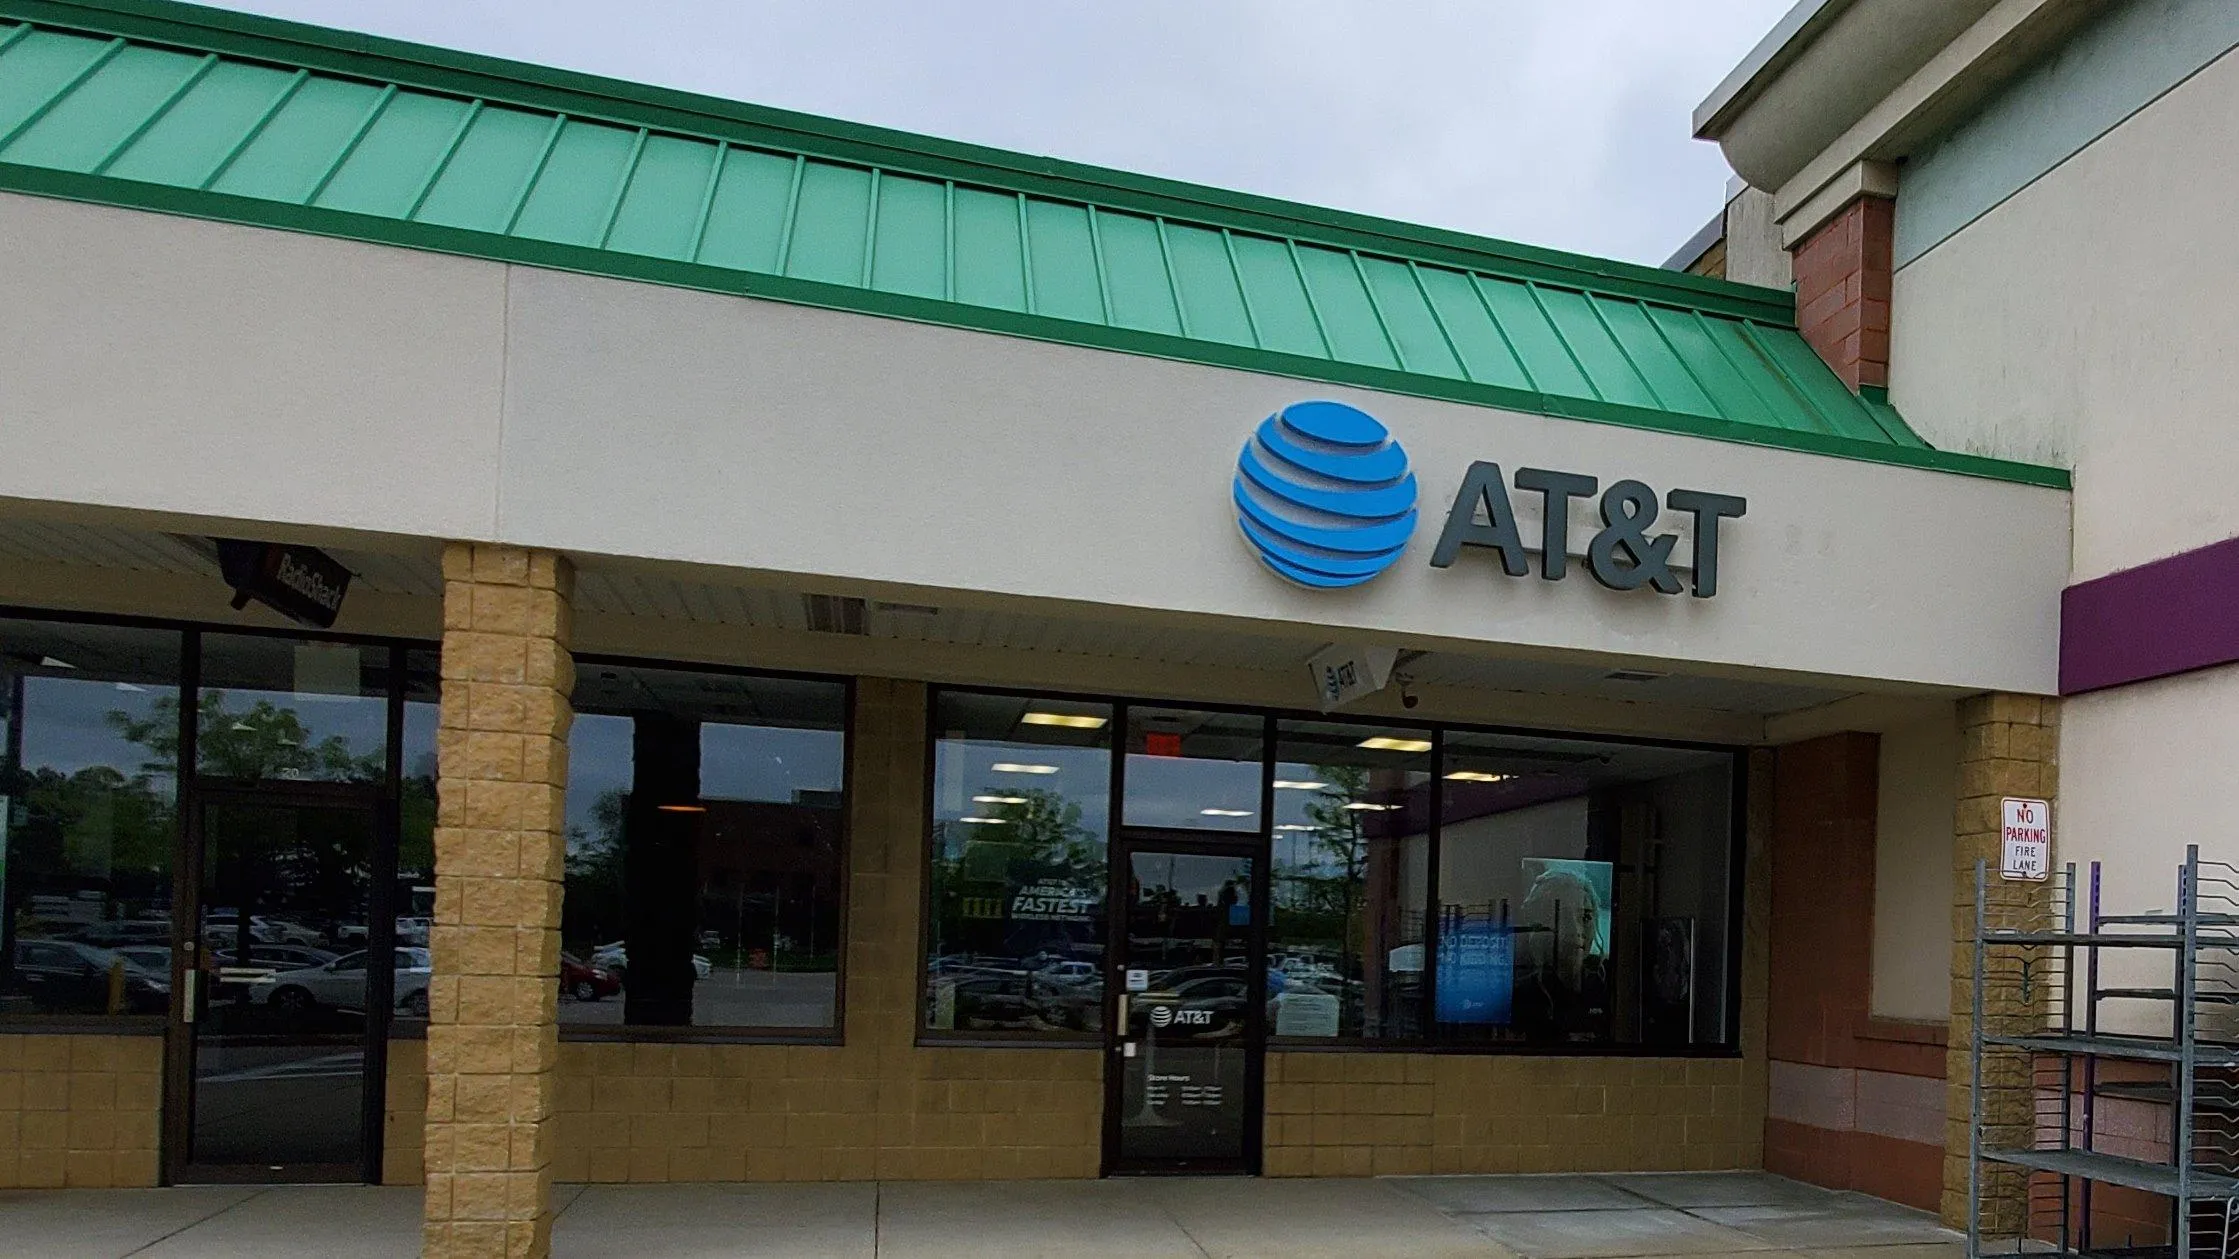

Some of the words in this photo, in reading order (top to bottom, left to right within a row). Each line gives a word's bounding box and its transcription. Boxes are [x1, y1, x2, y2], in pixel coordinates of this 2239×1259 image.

[1430, 461, 1747, 598] AT&T
[278, 553, 341, 613] RadioShack
[2016, 809, 2034, 824] NO
[2006, 827, 2046, 843] PARKING
[2015, 846, 2036, 857] FIRE
[2013, 860, 2037, 871] LANE
[1011, 897, 1094, 914] FASTEST
[1173, 1010, 1215, 1024] AT&T
